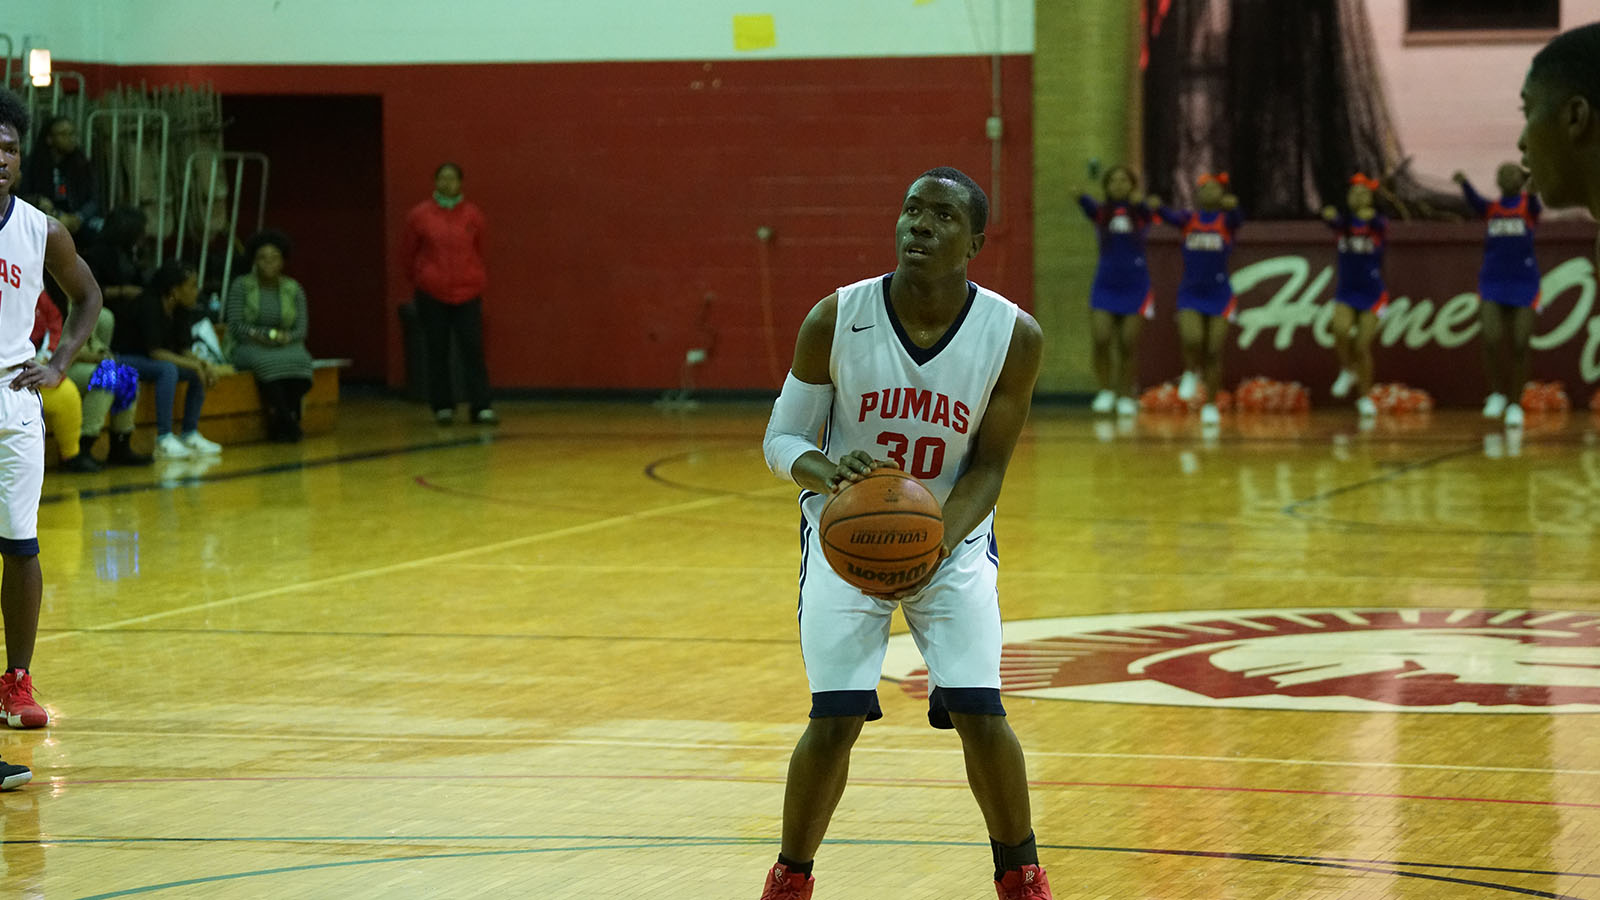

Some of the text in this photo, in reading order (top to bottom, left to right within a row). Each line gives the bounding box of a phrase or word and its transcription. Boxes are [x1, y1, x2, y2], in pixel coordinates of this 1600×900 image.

[858, 387, 970, 434] PUMAS
[876, 431, 946, 480] 30
[850, 531, 928, 544] EVOLUTION
[847, 562, 928, 585] Wilson
